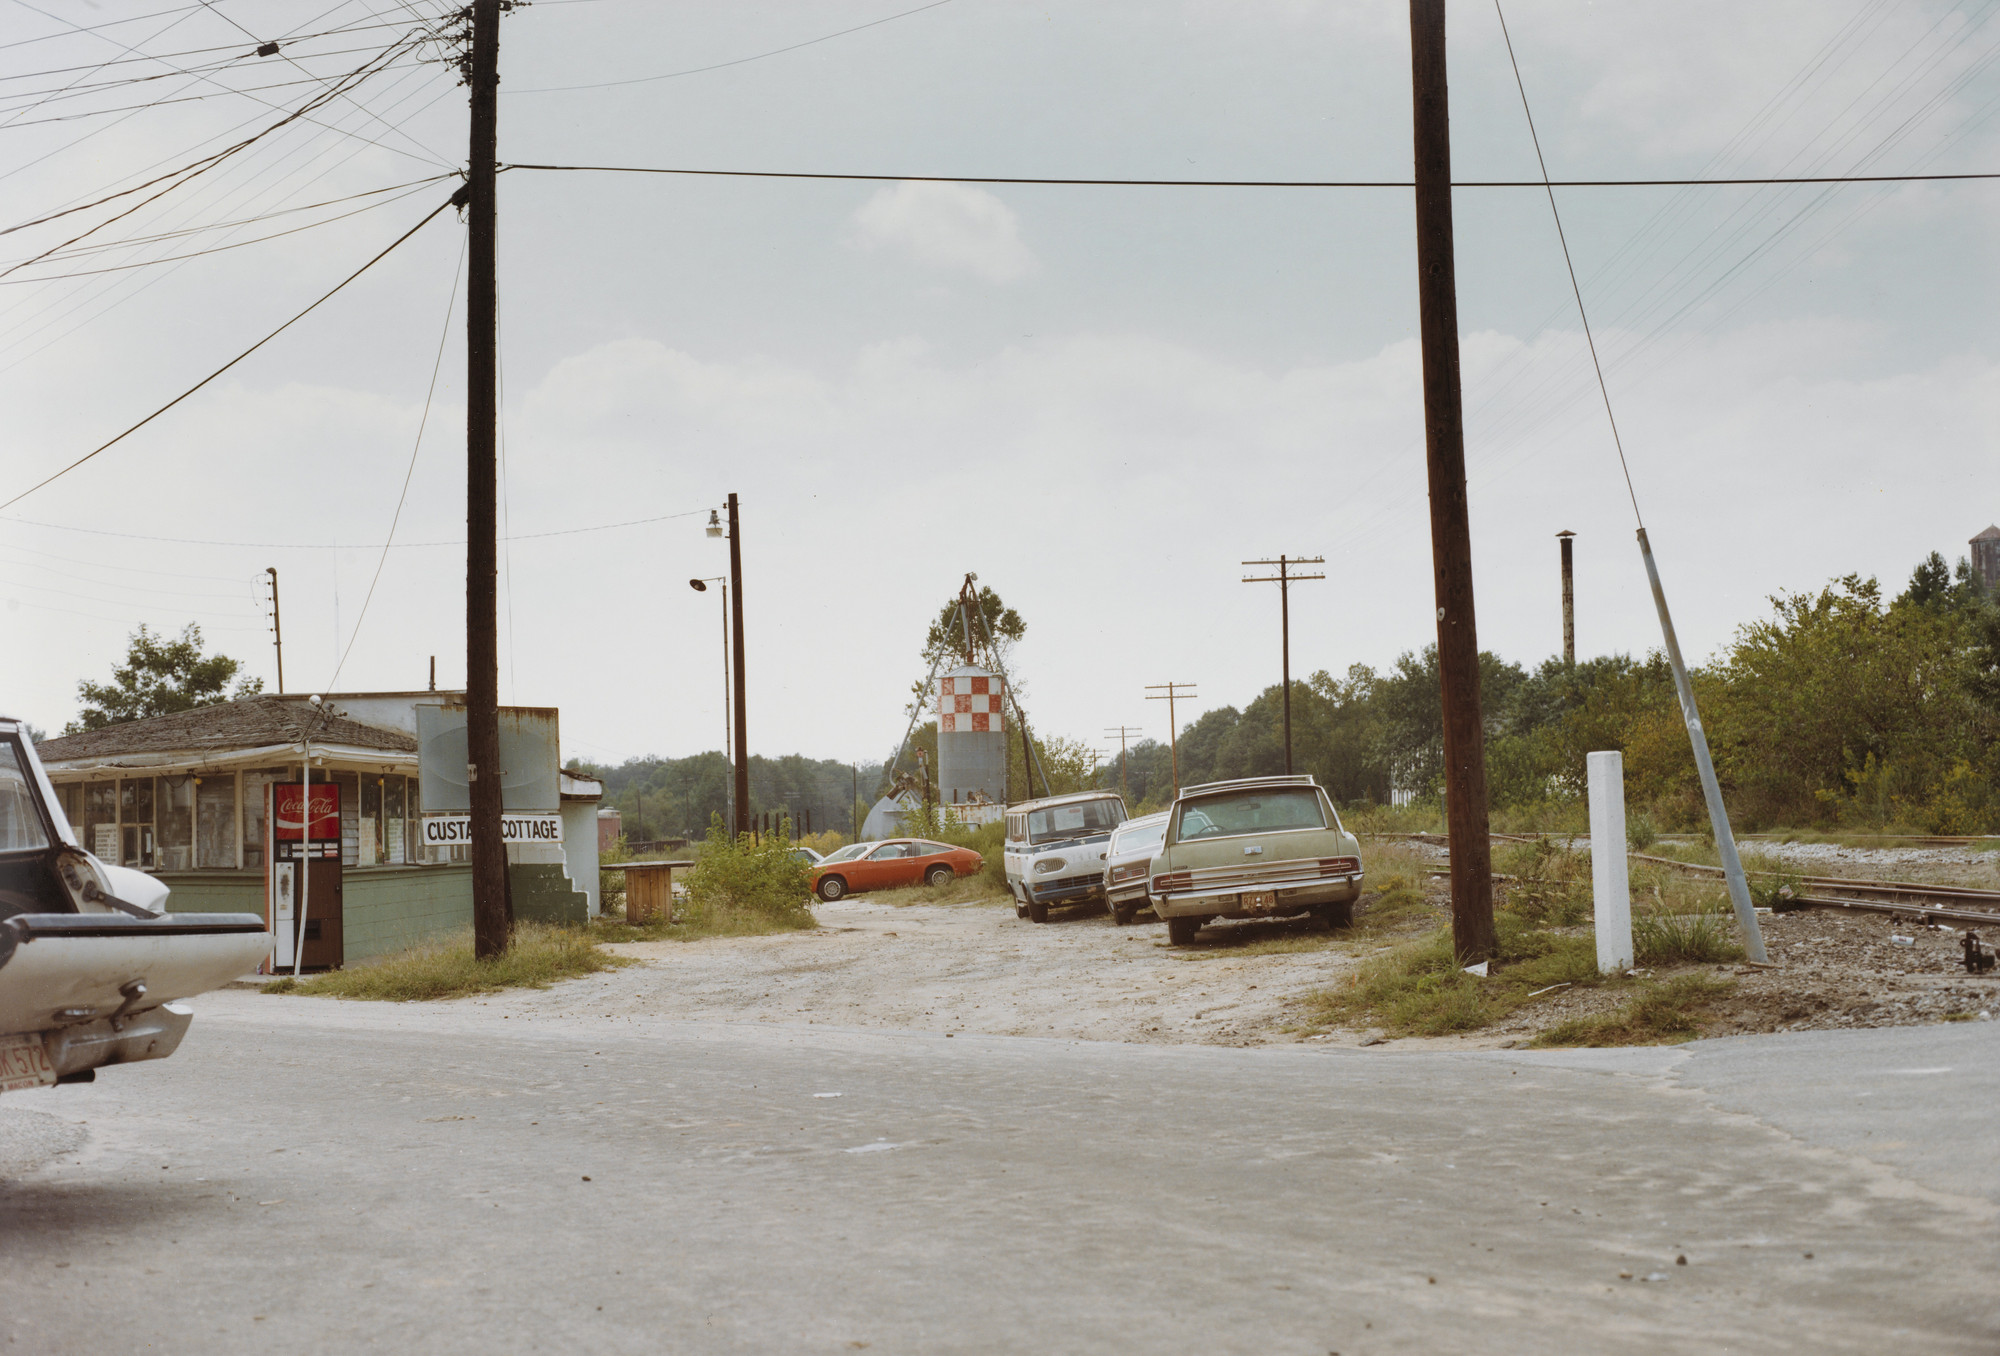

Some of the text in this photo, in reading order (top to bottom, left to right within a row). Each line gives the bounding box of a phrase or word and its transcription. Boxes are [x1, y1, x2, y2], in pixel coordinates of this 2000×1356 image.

[281, 797, 334, 814] CocaCola
[427, 820, 558, 840] CUSTA COTTAGE
